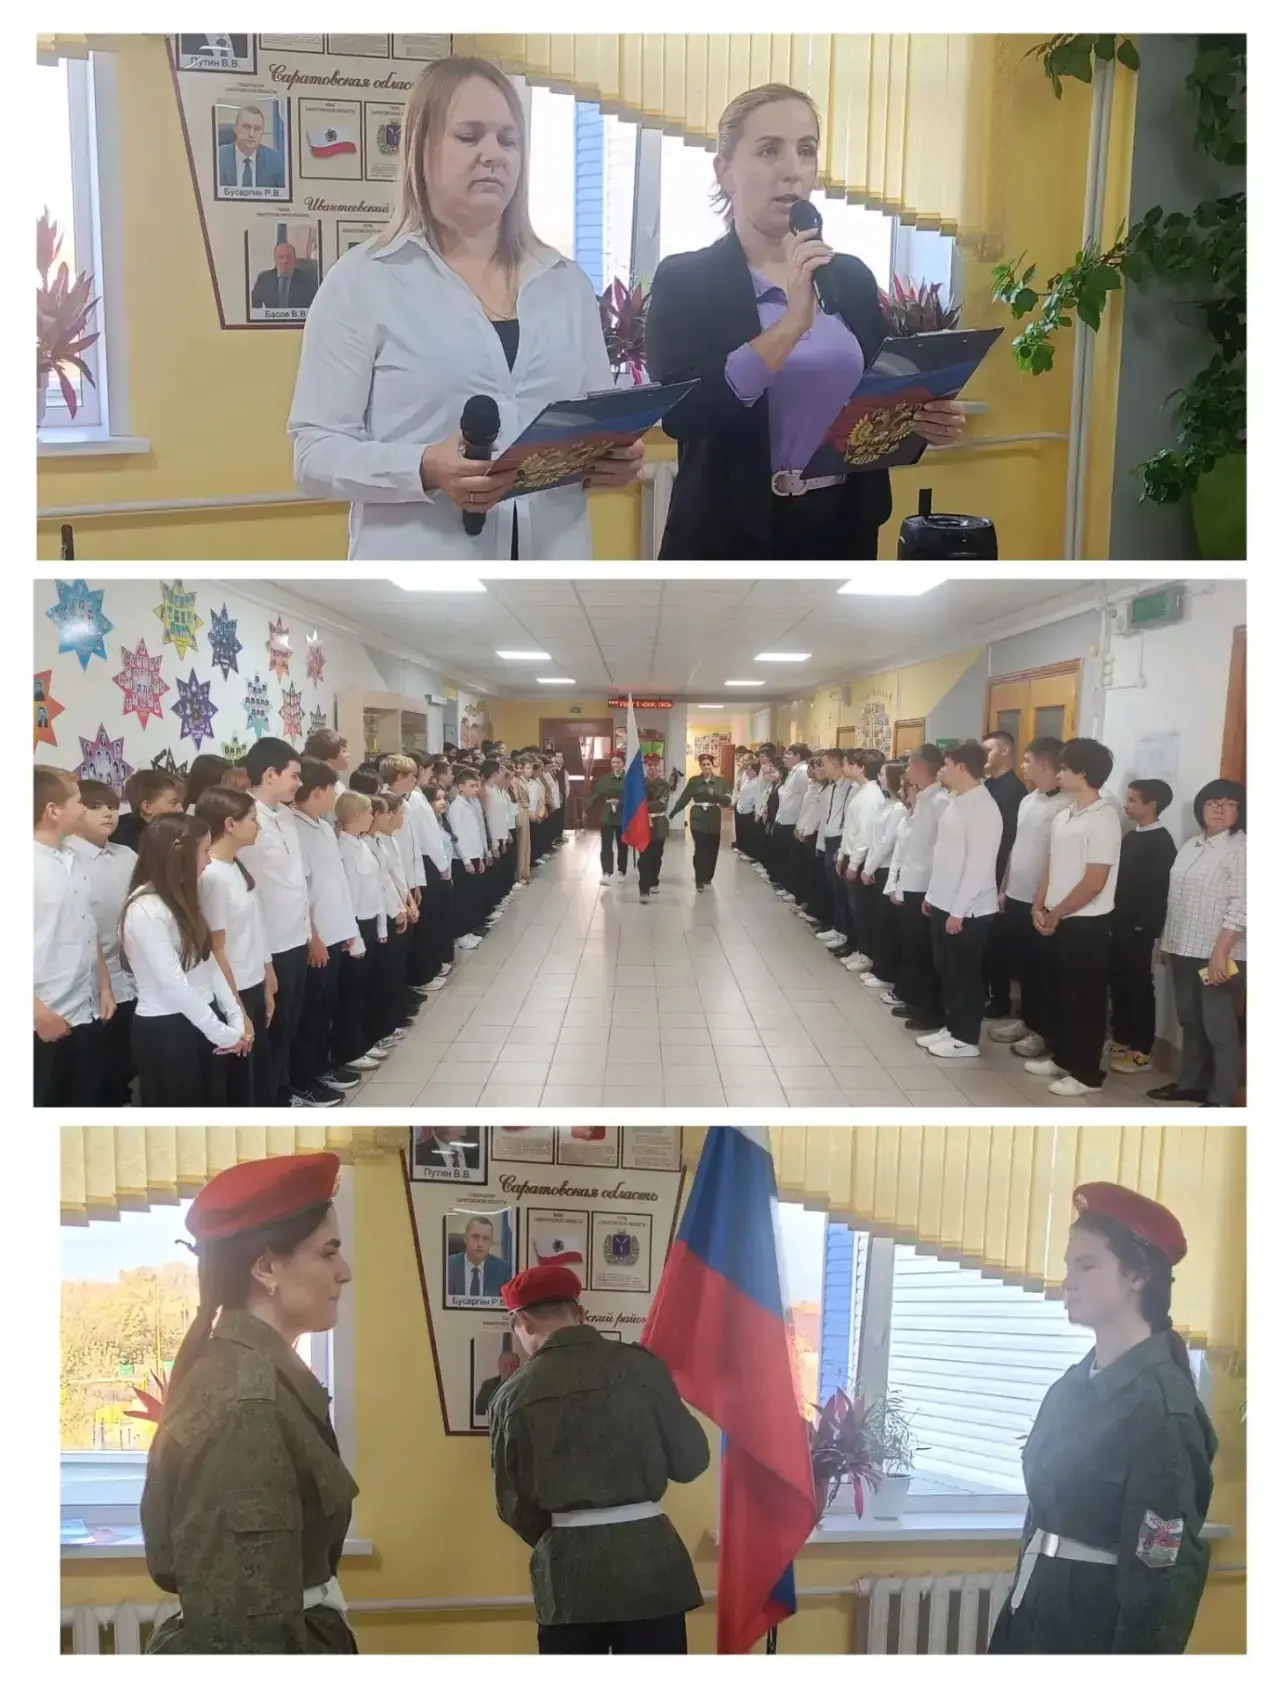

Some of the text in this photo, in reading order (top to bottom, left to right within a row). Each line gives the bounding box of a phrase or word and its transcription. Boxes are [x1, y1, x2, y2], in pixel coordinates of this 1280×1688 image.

[190, 57, 220, 68] Путин
[268, 63, 370, 91] Саратовская
[373, 71, 413, 91] облас
[304, 196, 389, 214] Ивантеевский
[423, 1167, 452, 1179] Путин
[499, 1173, 659, 1202] Саратовская область
